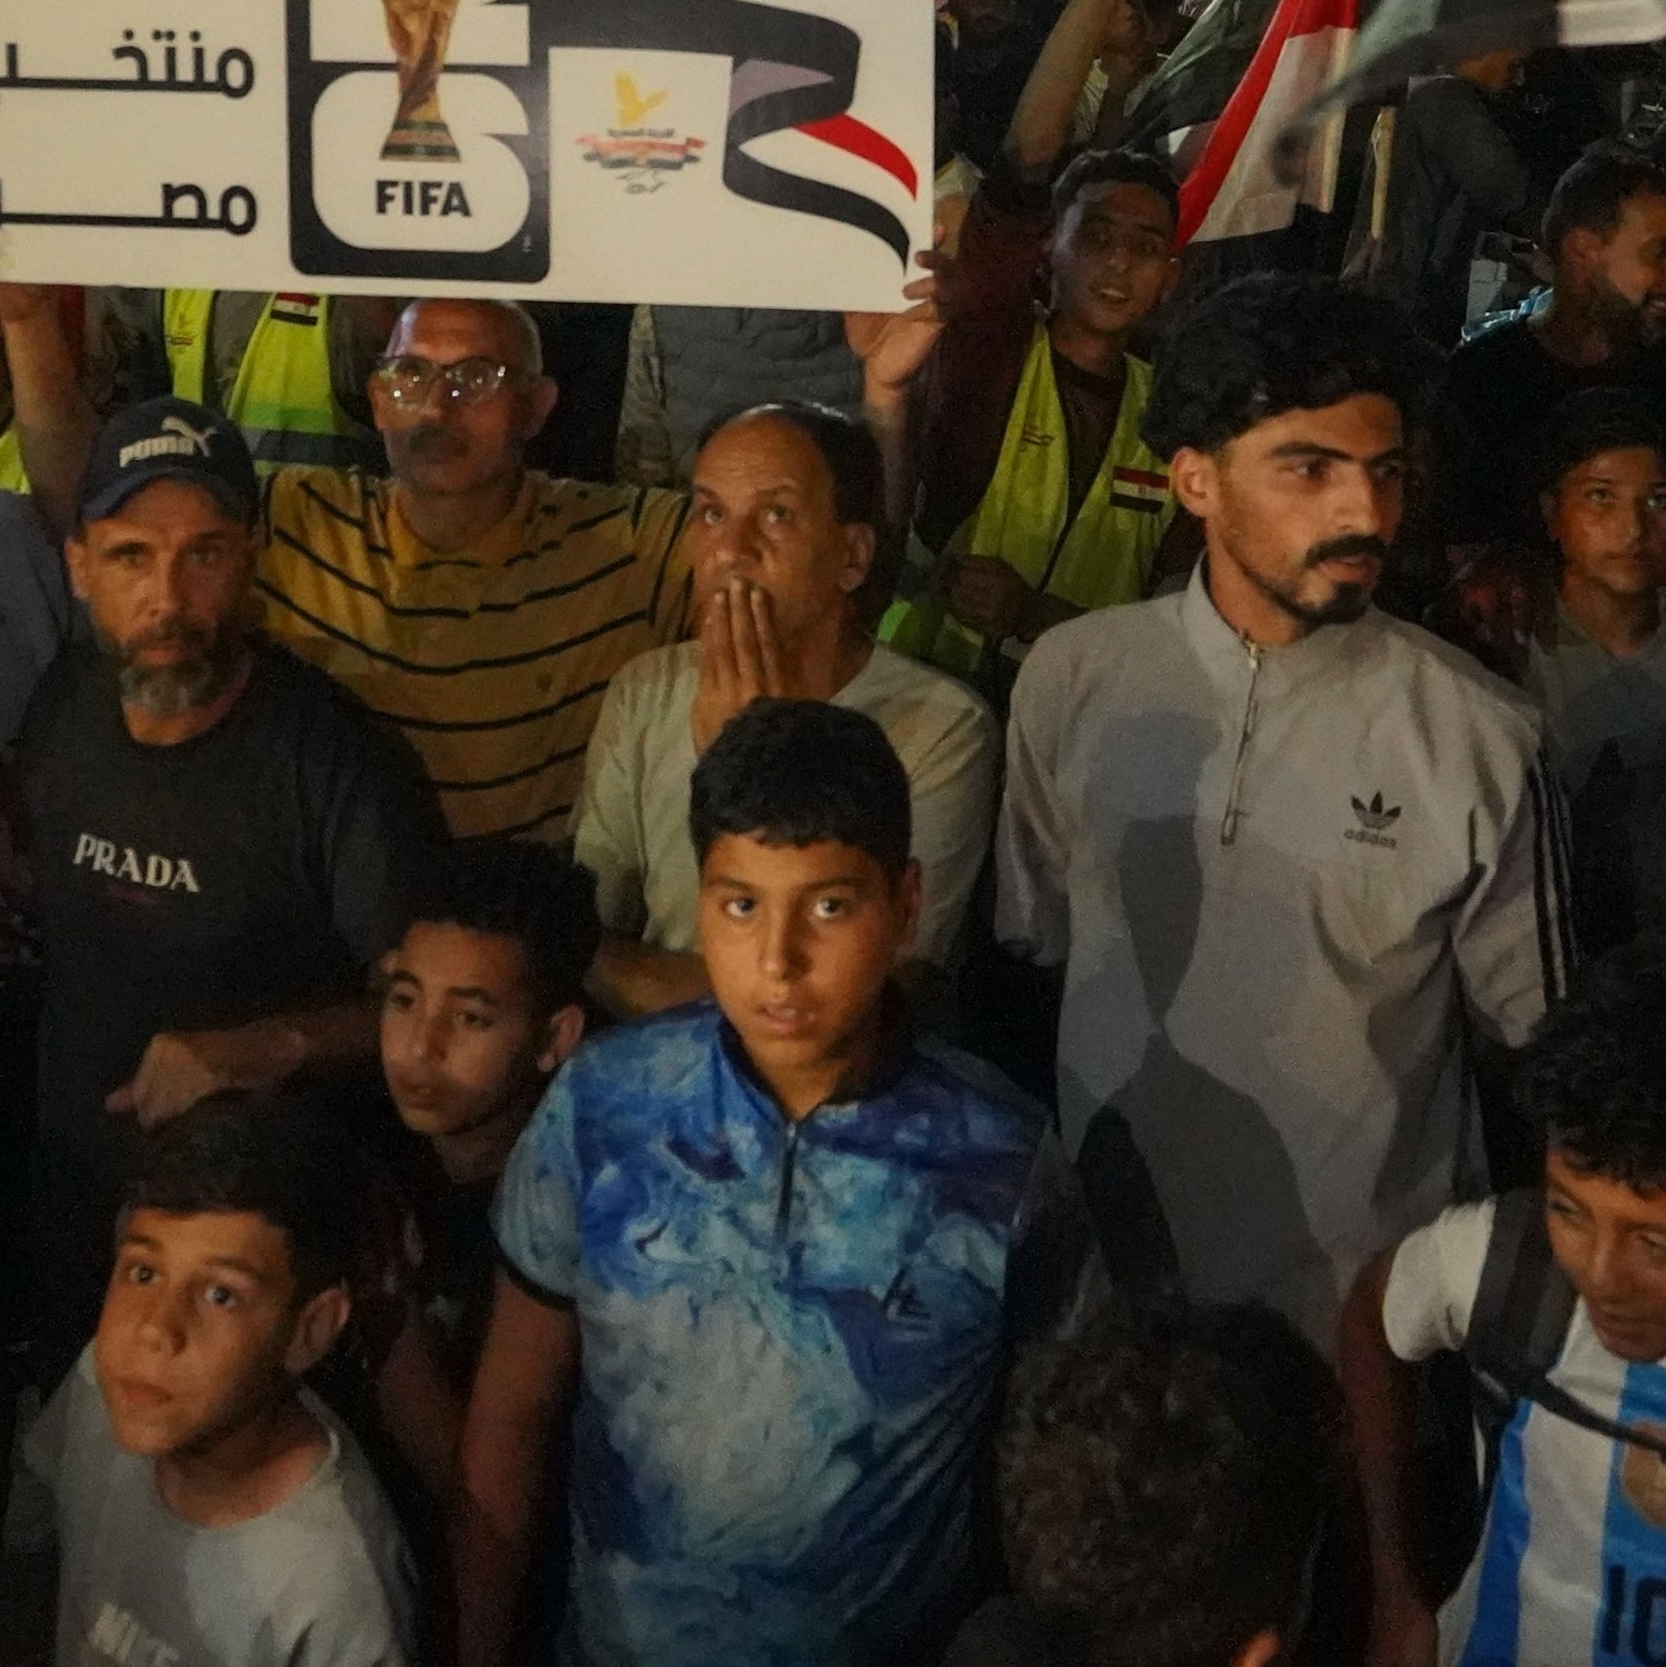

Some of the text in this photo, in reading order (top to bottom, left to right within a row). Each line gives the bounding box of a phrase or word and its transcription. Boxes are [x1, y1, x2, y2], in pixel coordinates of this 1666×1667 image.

[375, 180, 473, 219] FIFA
[1344, 829, 1398, 850] adidas
[72, 832, 200, 894] PRADA
